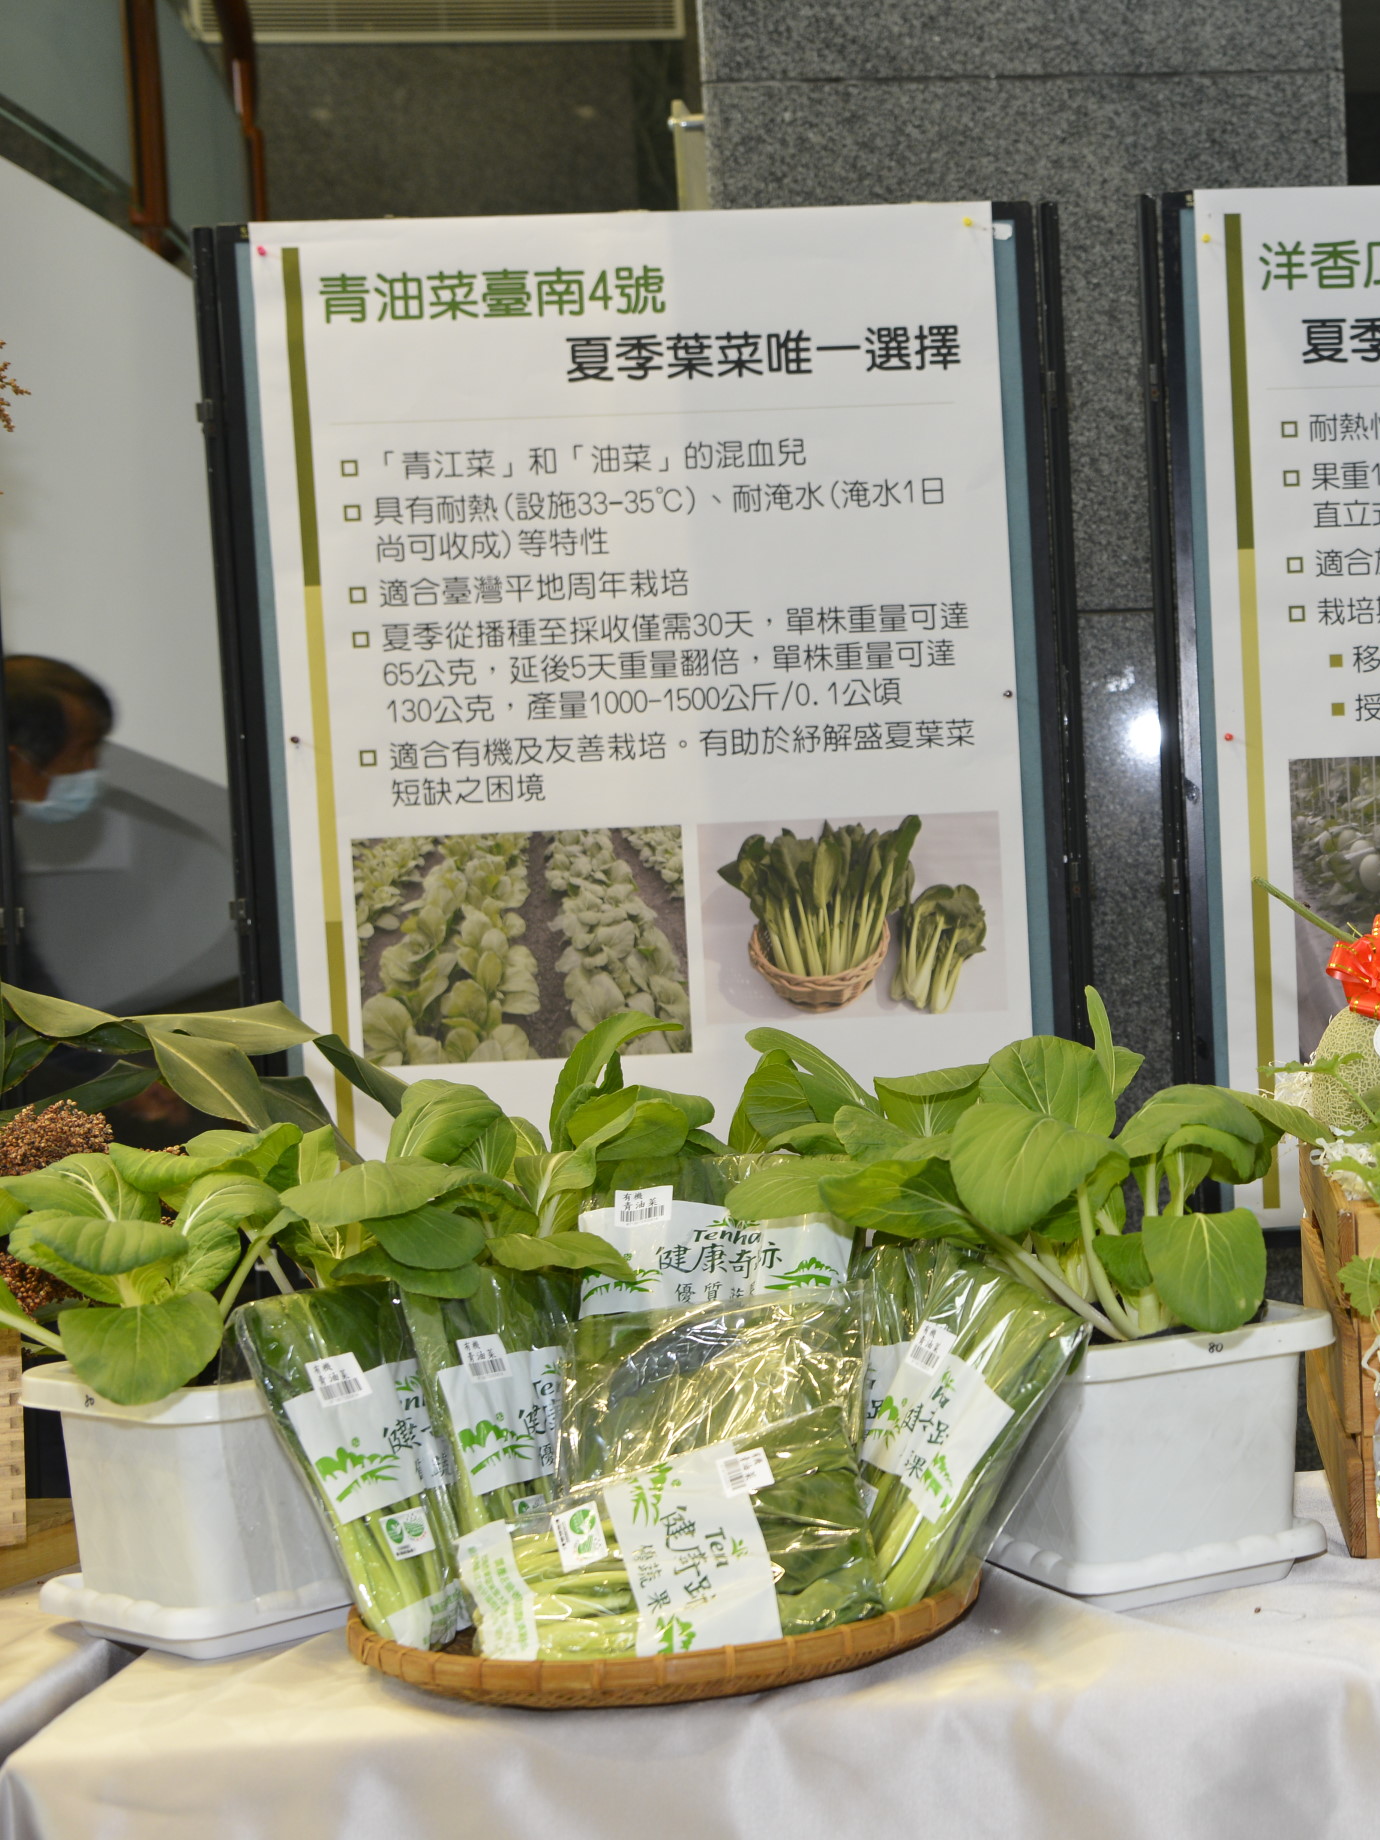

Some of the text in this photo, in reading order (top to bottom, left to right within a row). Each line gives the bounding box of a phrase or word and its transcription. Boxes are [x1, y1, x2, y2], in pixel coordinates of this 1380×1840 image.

[318, 265, 667, 323] 青油菜臺南4號
[566, 325, 962, 383] 夏季葉菜唯一選擇
[383, 438, 807, 480] 「青江菜」和「油菜」的混血兒
[376, 528, 610, 562] 尚可收成)等特性
[379, 568, 688, 608] 適合臺灣平地周年栽培
[382, 602, 970, 652] 夏季從播種至採收僅需30天，單株重量可達
[383, 640, 956, 688] 65公克，延後5天重量翻倍，單株重量可達
[389, 719, 975, 771] 適合有機及友善栽培。有助於紓解盛夏葉菜
[392, 773, 546, 808] 短缺之困境
[1208, 1342, 1224, 1353] 80
